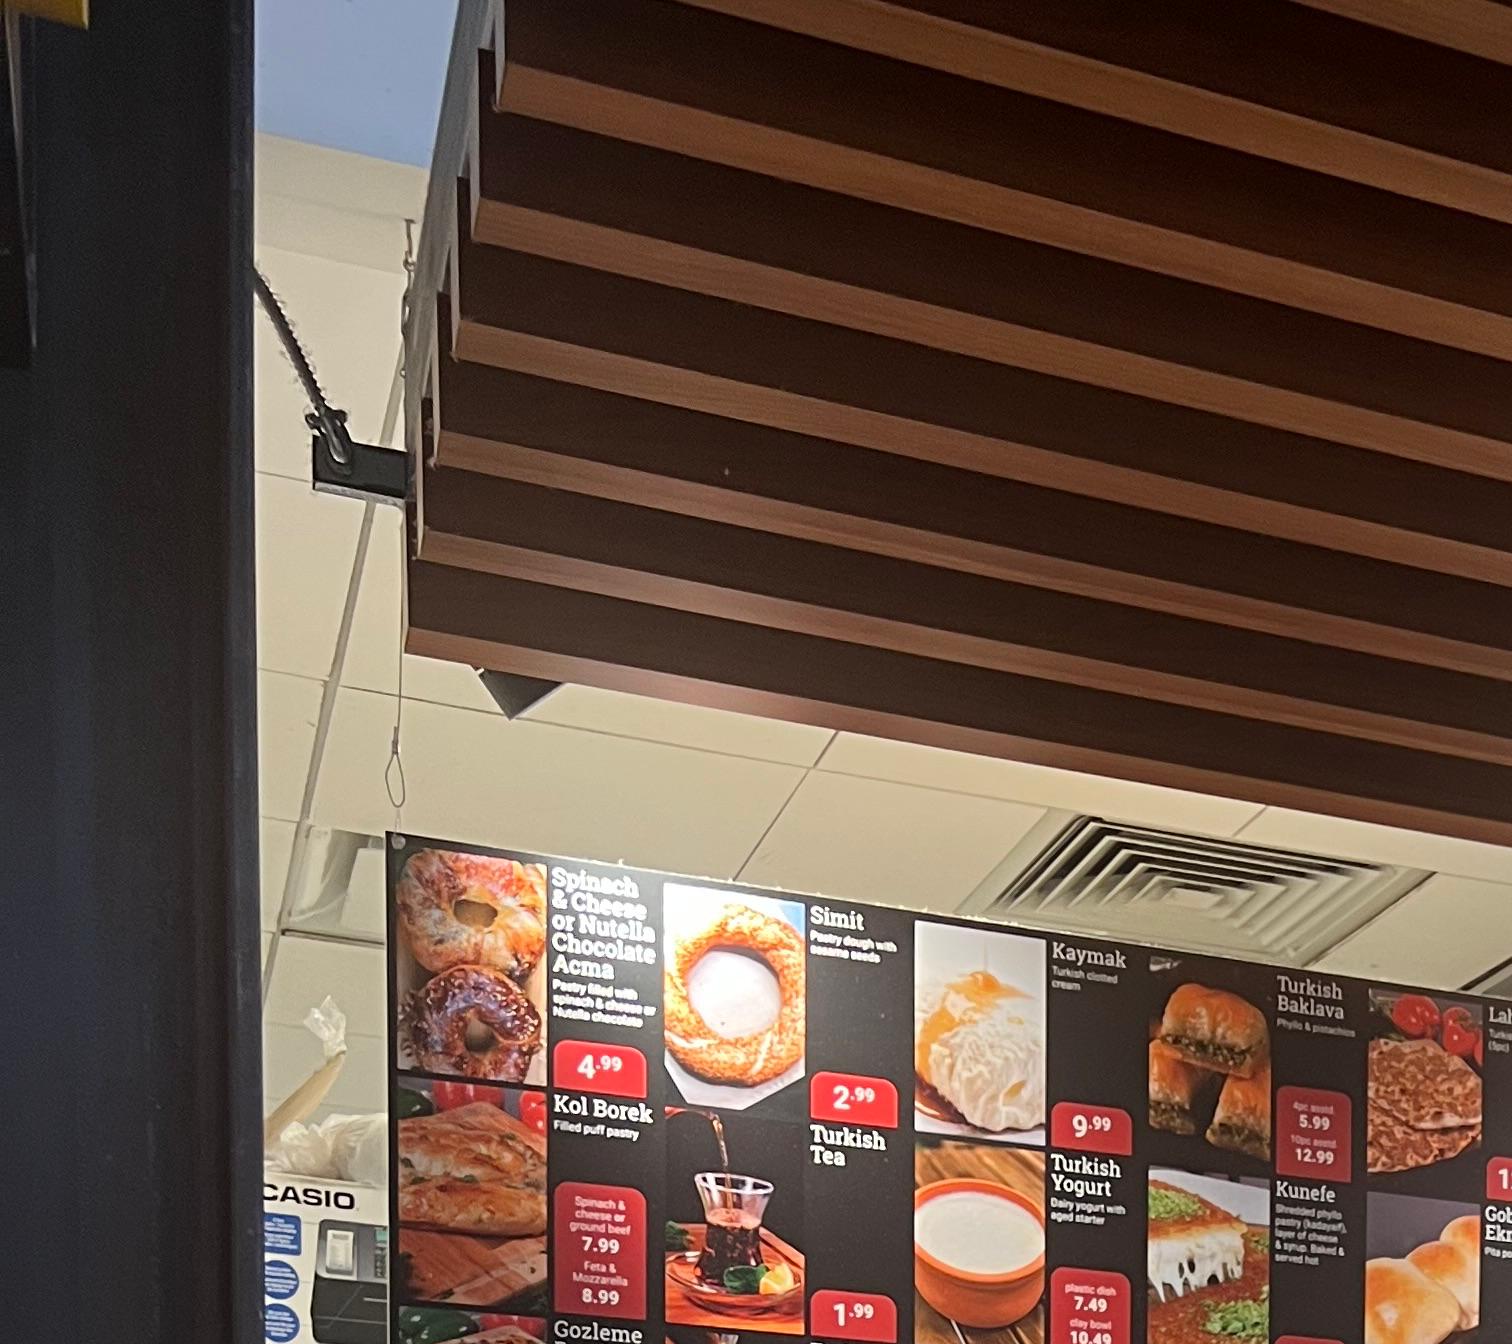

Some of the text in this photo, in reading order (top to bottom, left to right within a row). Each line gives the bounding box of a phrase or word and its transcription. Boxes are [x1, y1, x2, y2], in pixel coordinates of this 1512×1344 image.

[552, 867, 639, 898] Spinach
[552, 889, 647, 920] & Cheese
[552, 913, 655, 943] or Nutella
[810, 905, 865, 931] Simit
[552, 932, 656, 964] Chocolate
[1052, 942, 1127, 968] Kaymak
[553, 954, 614, 979] Acma
[1277, 975, 1343, 1000] Turkish
[1277, 994, 1344, 1020] Baklava
[577, 1054, 622, 1079] 4.99
[553, 1094, 653, 1123] Kol Borek
[832, 1085, 876, 1111] 2.99
[553, 1120, 640, 1141] Filled pastry
[1072, 1114, 1112, 1138] 9.99
[1299, 1116, 1331, 1131] 5.99
[809, 1124, 887, 1151] Turkish
[809, 1144, 846, 1167] Tea
[1050, 1153, 1122, 1178] Turkish
[1295, 1148, 1335, 1165] 12.99
[263, 1184, 355, 1210] CASIO
[1051, 1173, 1112, 1197] Yogurt
[1275, 1181, 1336, 1203] Kunefe
[574, 1196, 616, 1210] Spinach
[582, 1236, 620, 1254] 7.99
[572, 1272, 628, 1286] Mozzarella
[582, 1288, 620, 1305] 8.99
[1074, 1296, 1107, 1312] 7.49
[833, 1303, 874, 1327] 1.99
[554, 1320, 643, 1344] Gozleme
